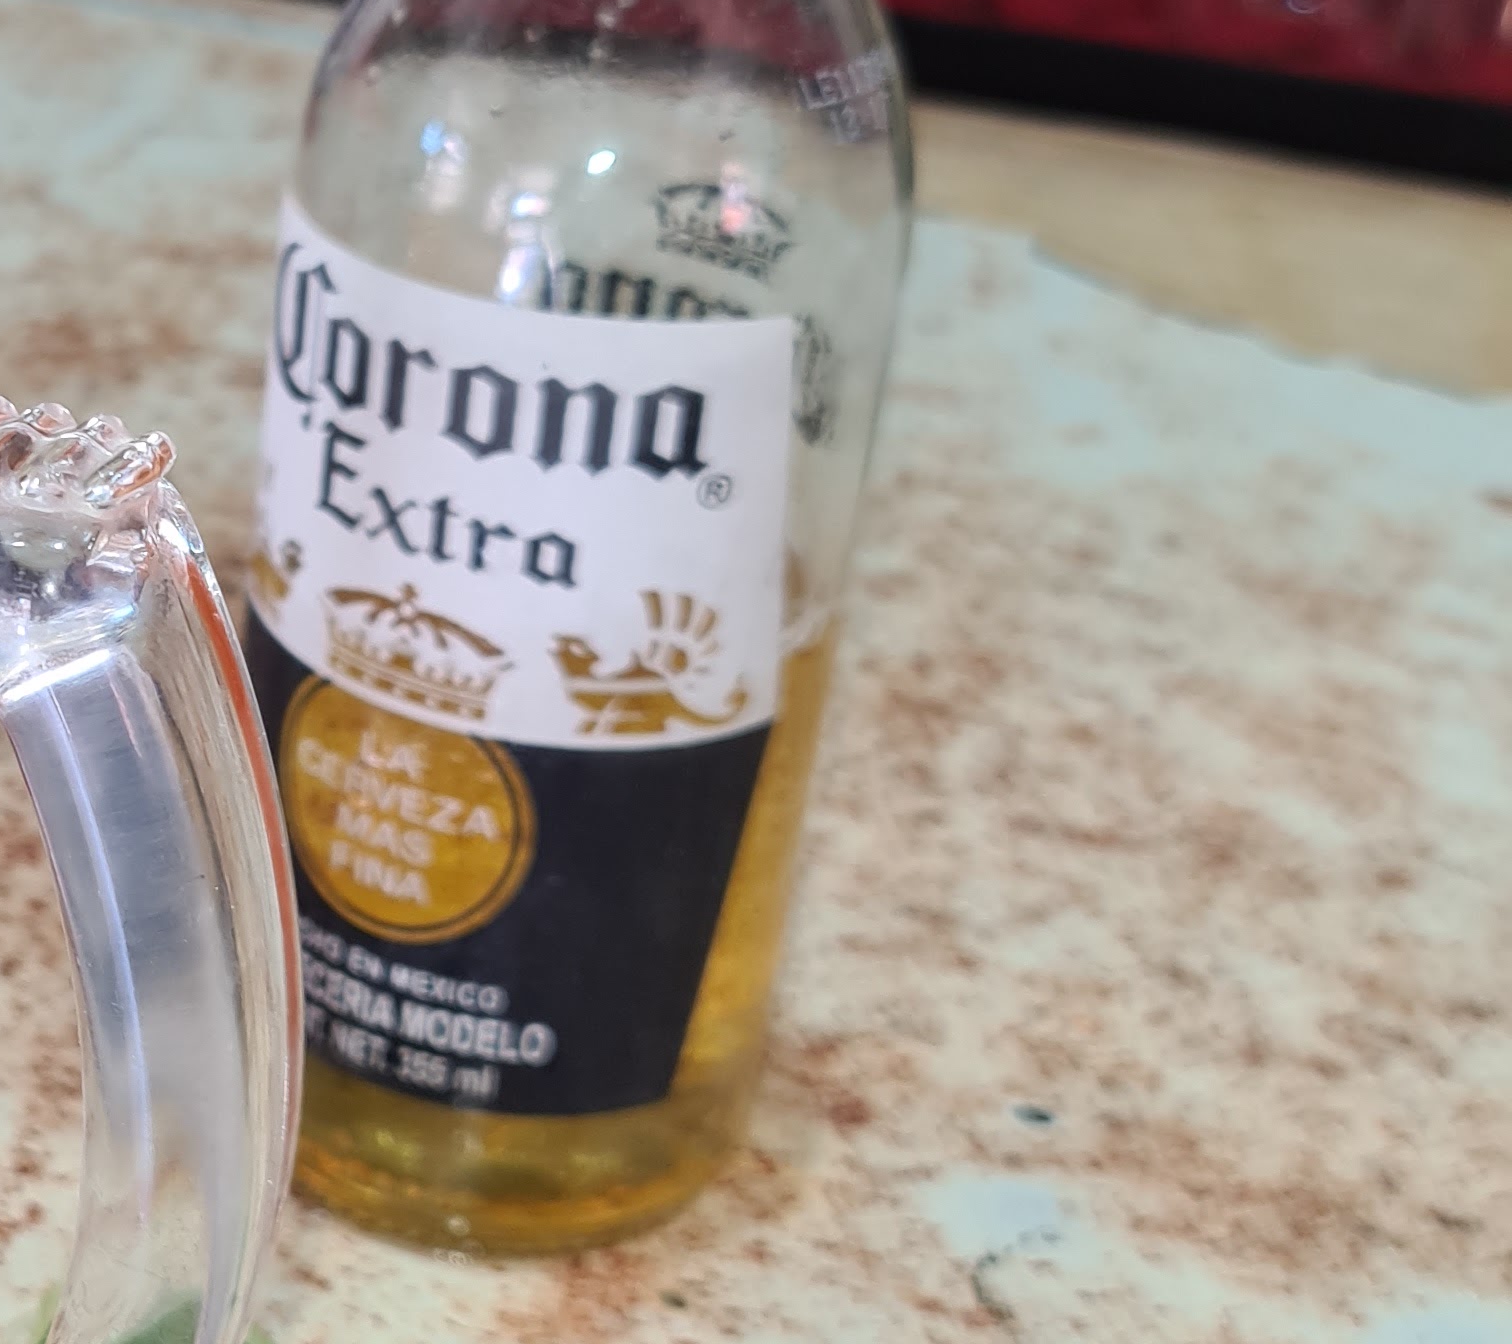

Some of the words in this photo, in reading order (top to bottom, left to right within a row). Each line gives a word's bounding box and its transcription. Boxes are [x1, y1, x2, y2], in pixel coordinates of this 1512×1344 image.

[274, 242, 708, 480] Corona
[315, 421, 580, 589] Extra
[327, 840, 431, 908] FINA
[389, 961, 509, 1016] MEXICO
[397, 998, 558, 1068] MODELO
